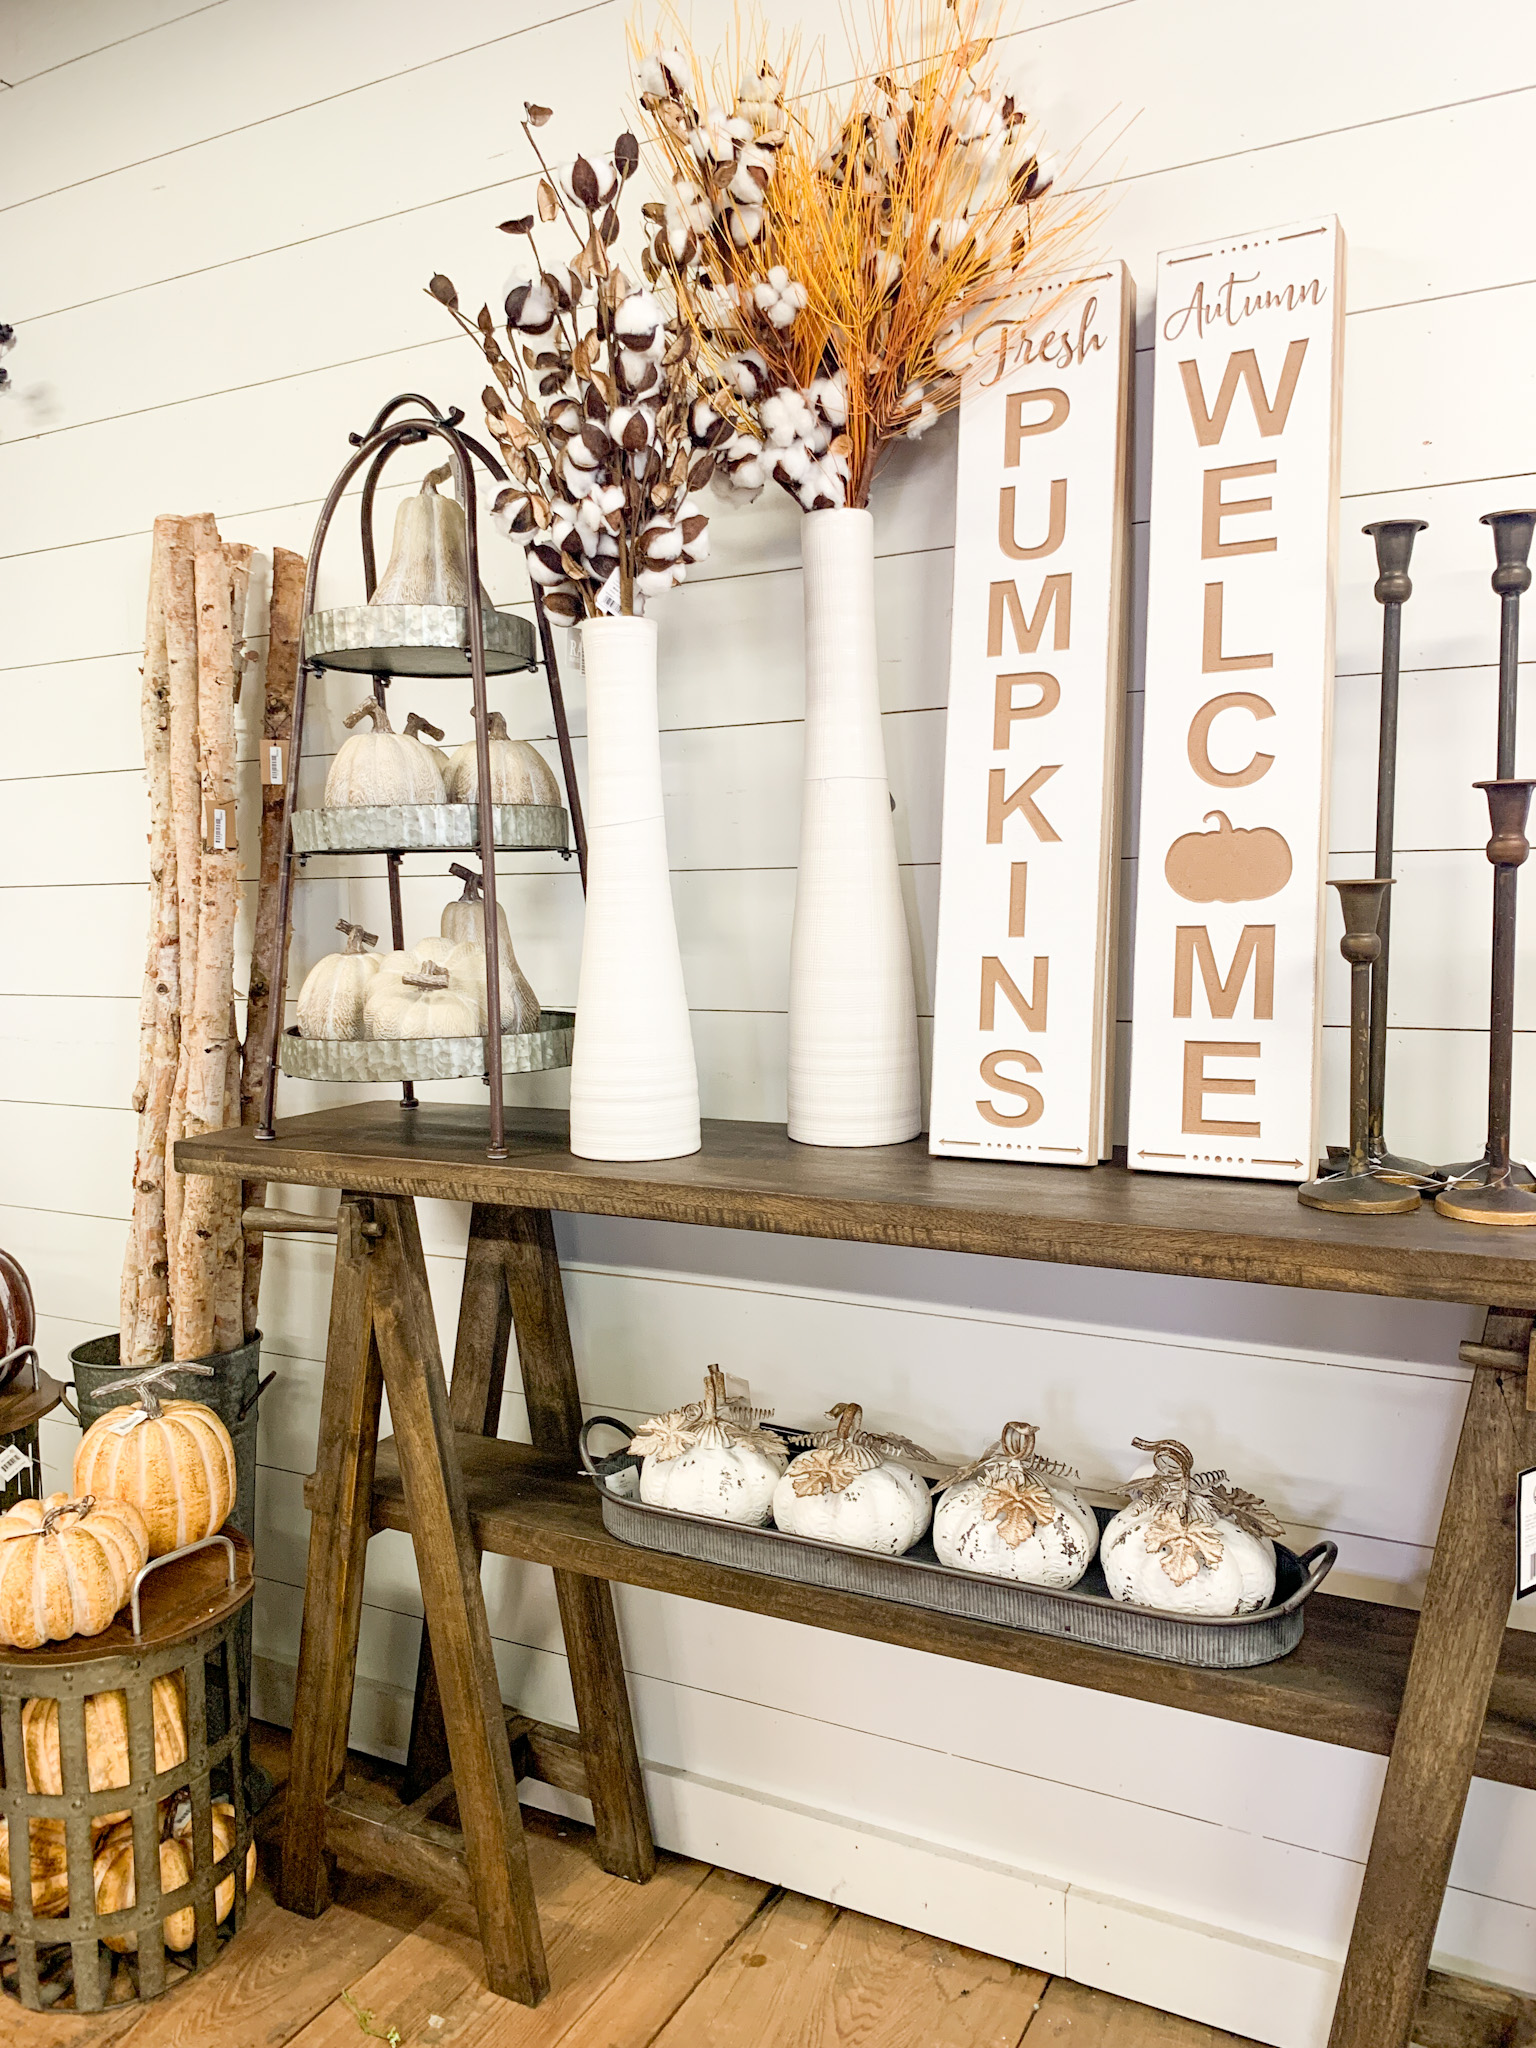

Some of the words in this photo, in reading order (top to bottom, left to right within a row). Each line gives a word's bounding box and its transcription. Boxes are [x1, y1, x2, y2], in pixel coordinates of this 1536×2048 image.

[973, 296, 1107, 387] Fresh
[1163, 271, 1328, 341] Autumn
[976, 387, 1073, 1129] PUMPKINS
[1165, 337, 1310, 1139] WELCME
